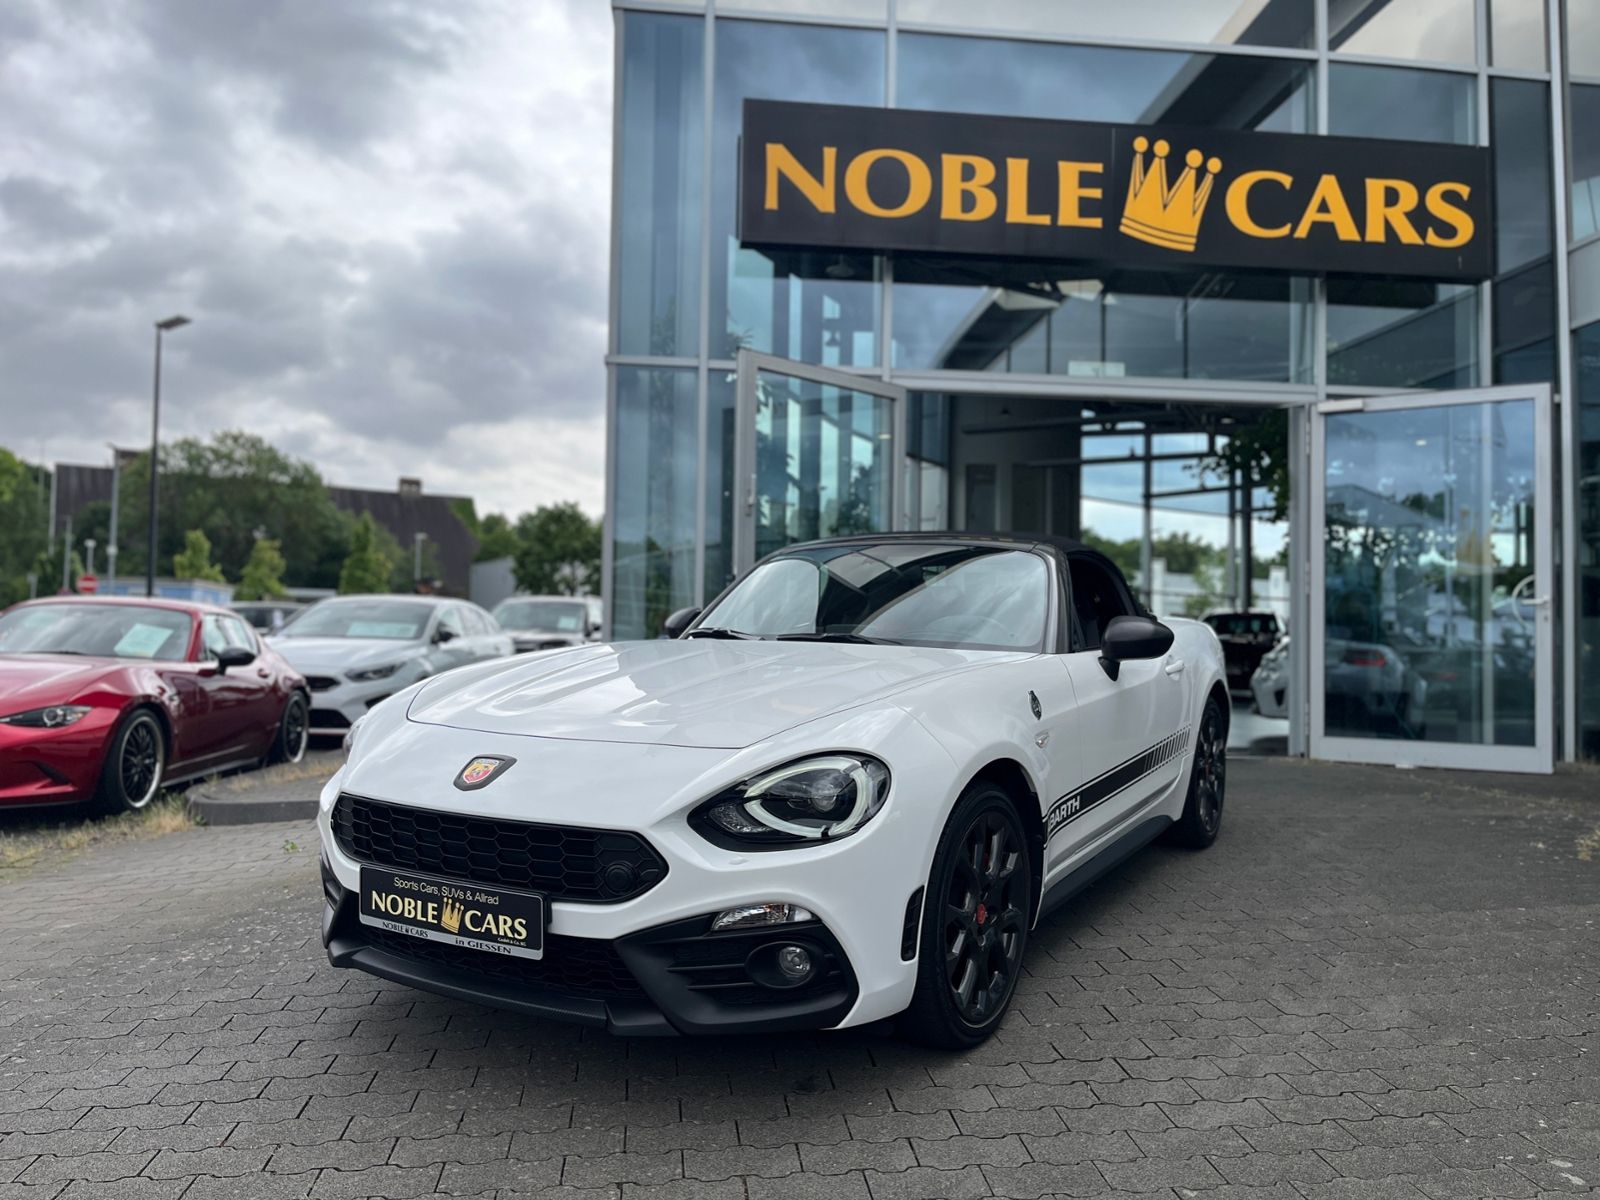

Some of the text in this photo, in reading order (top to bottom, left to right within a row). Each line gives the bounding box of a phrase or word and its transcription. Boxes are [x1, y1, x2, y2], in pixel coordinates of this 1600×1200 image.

[764, 142, 1476, 248] NOBLE CARS
[394, 876, 499, 905] Sports Cars, SUVs & Allrad
[371, 890, 528, 940] NOBLE CARS
[382, 921, 429, 938] NOBLE CARS
[455, 937, 465, 946] in
[467, 940, 512, 955] GIESSEN
